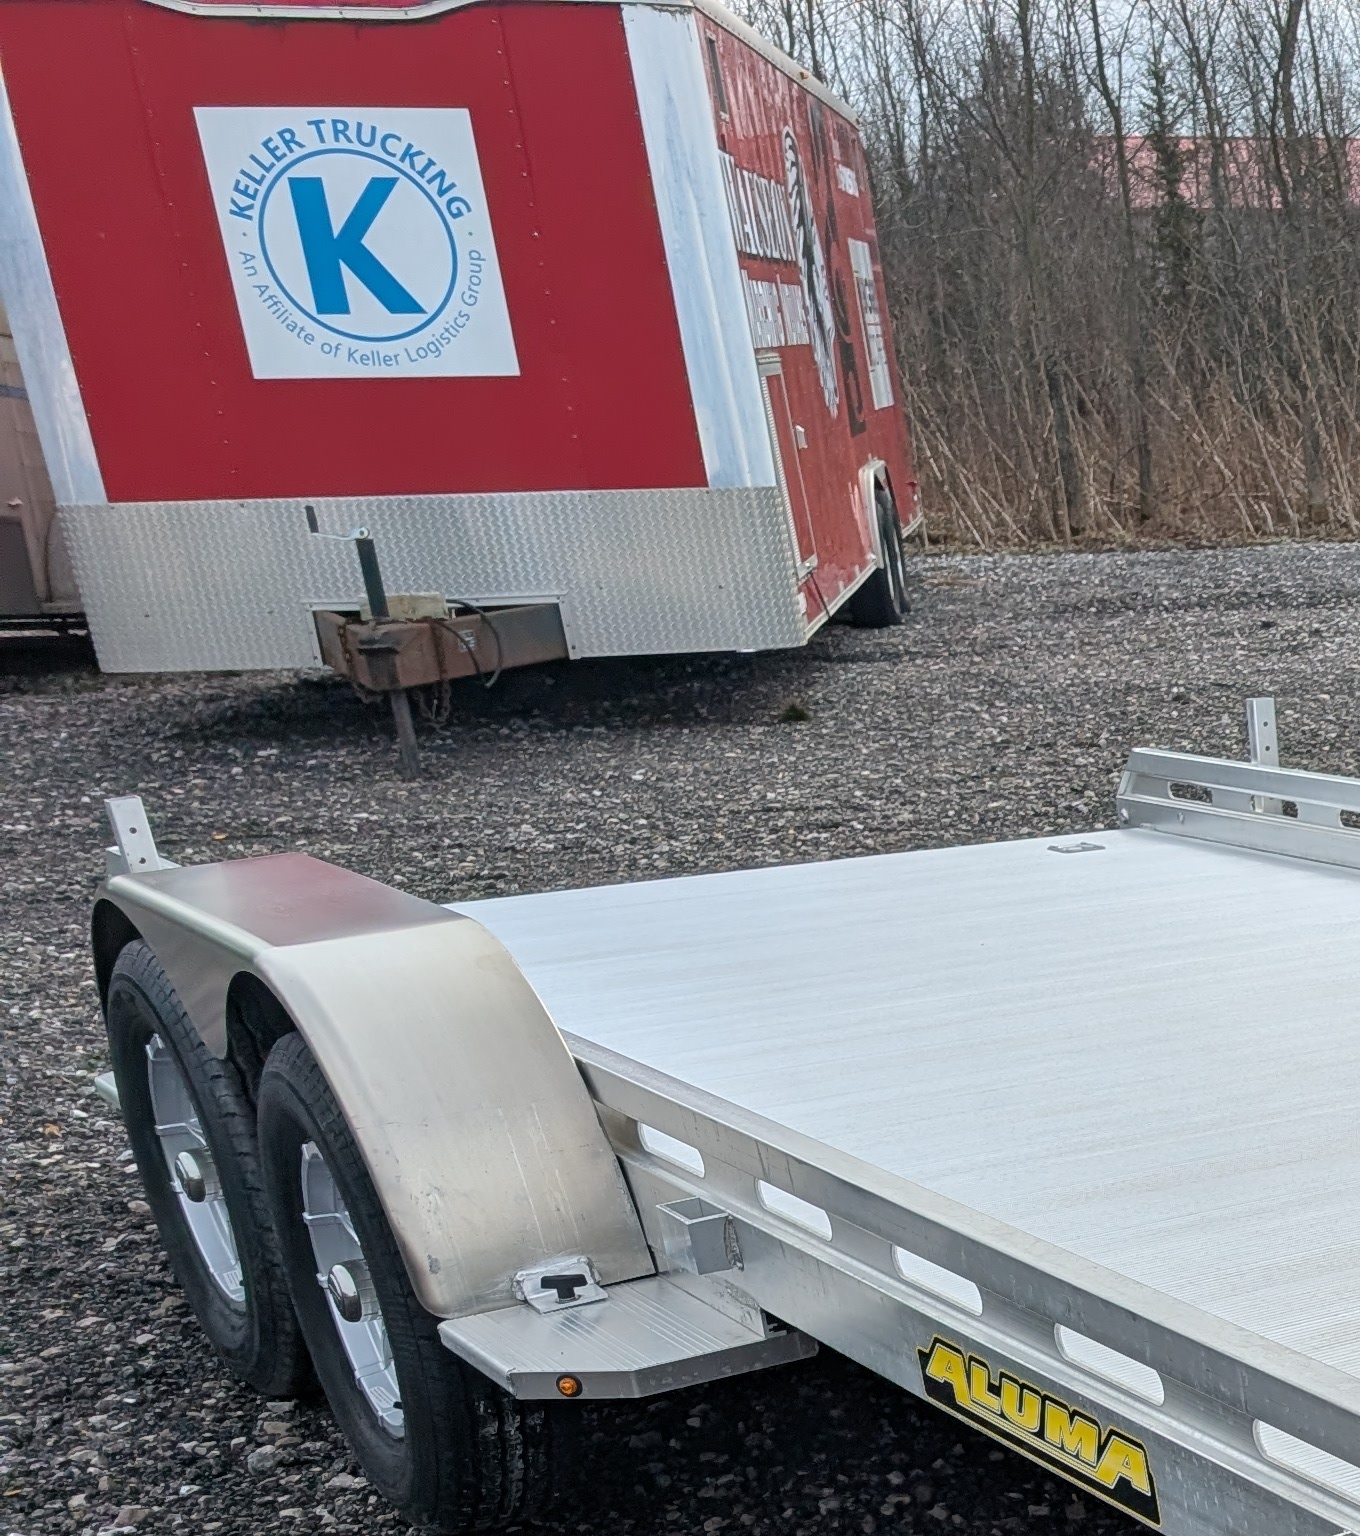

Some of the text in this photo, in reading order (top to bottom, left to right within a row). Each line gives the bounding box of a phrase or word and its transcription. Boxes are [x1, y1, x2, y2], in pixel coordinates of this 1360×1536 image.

[229, 118, 472, 221] KELLER TRUCKING
[238, 249, 486, 367] An Affiliate of Keller Logistics Group
[287, 176, 428, 315] K
[926, 1343, 1151, 1497] ALUMA
